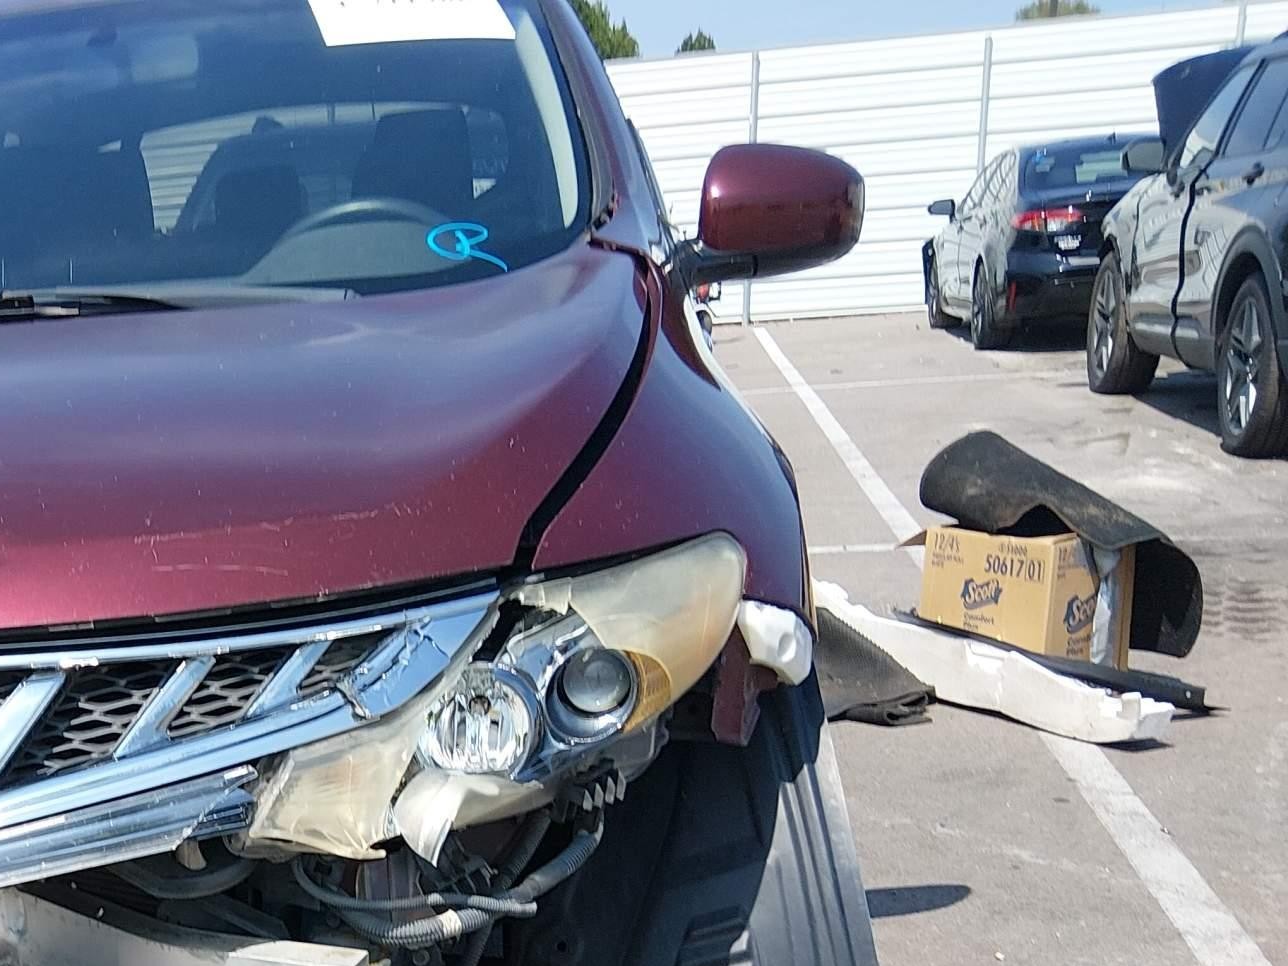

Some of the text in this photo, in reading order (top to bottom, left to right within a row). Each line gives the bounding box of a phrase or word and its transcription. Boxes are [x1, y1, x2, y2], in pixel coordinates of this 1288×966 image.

[984, 553, 1025, 578] 50617
[964, 578, 1000, 606] Scott
[1066, 596, 1097, 628] Sco
